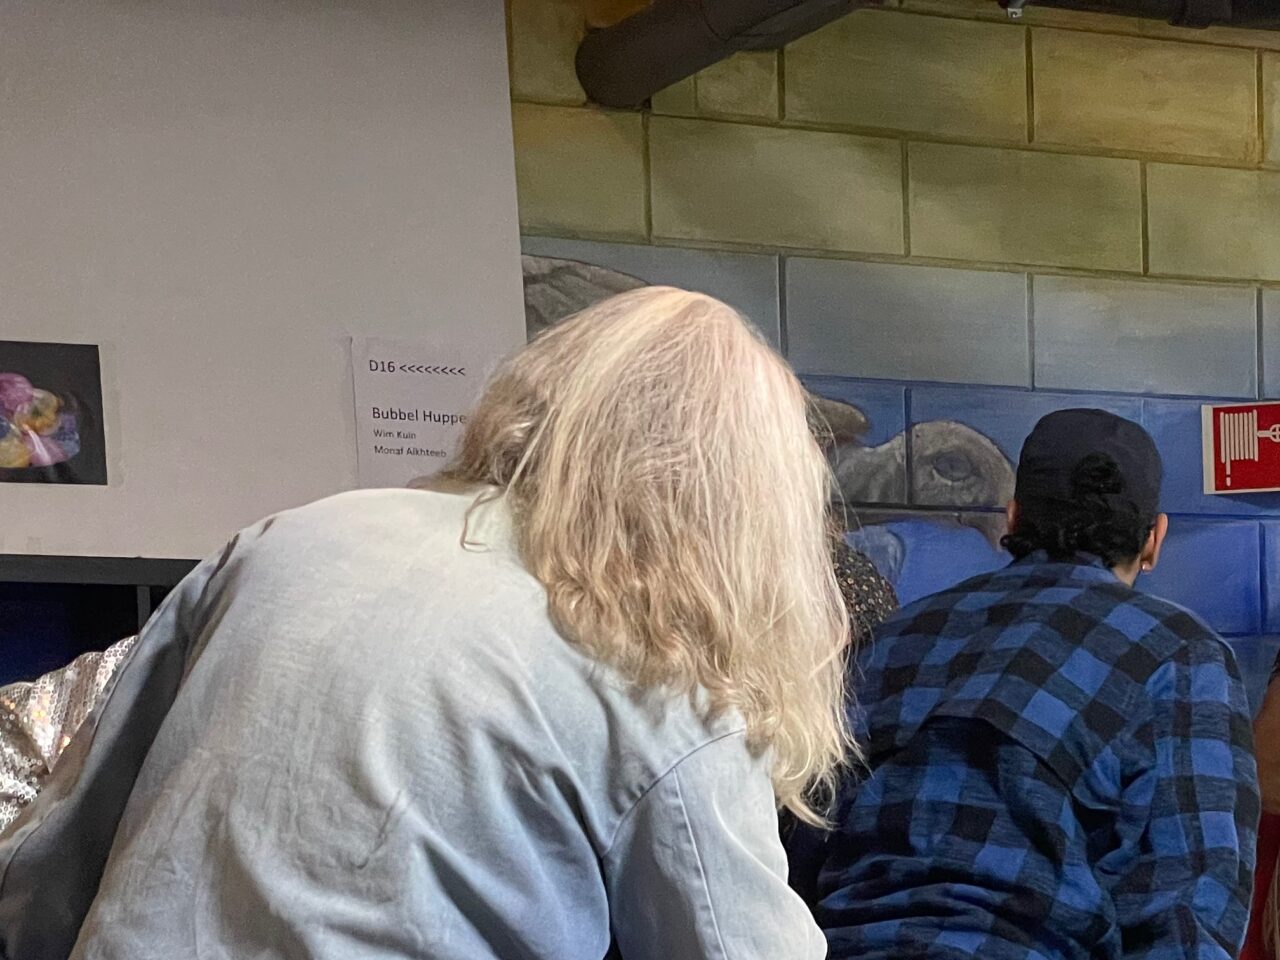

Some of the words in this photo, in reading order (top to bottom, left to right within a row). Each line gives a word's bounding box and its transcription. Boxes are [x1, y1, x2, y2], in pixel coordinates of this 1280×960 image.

[369, 360, 396, 373] D16
[372, 407, 419, 422] Bubbel
[423, 410, 468, 426] Huppe
[373, 429, 394, 438] Wim
